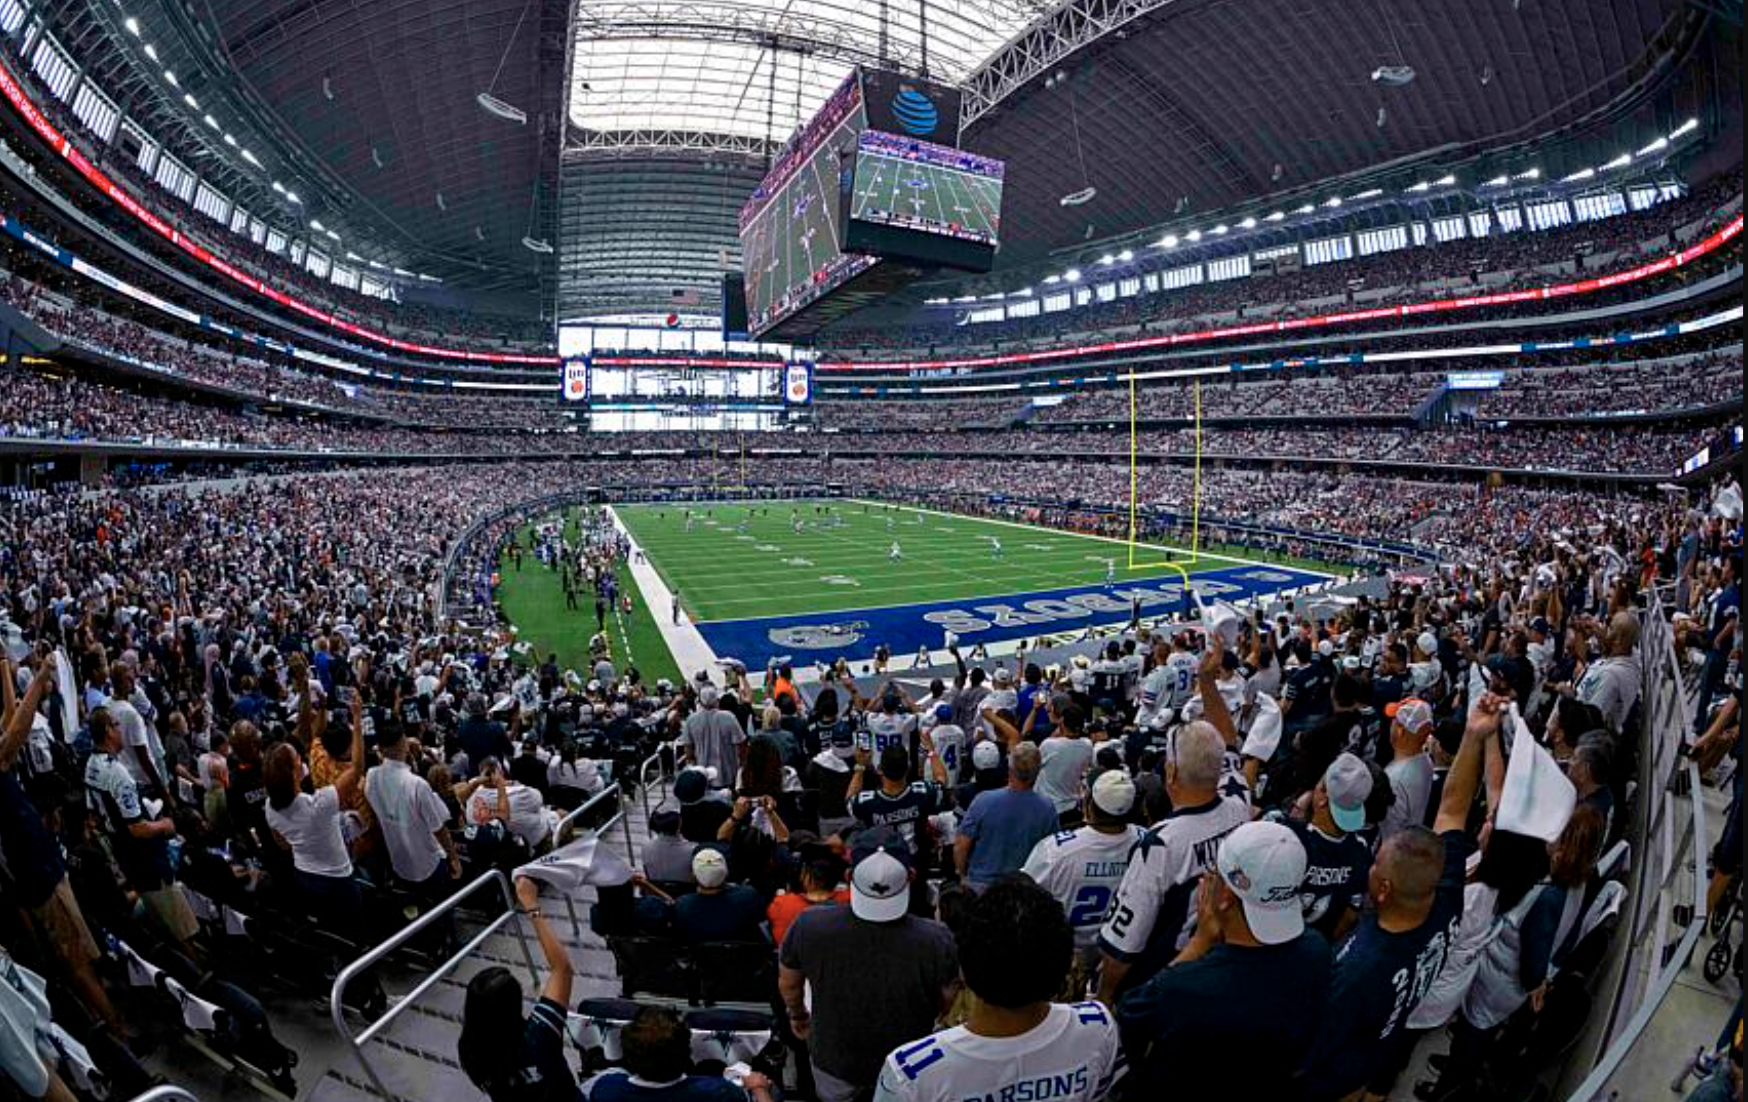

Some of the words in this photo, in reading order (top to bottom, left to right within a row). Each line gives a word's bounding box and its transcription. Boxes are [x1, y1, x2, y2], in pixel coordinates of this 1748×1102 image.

[871, 804, 920, 827] PARSONS
[895, 1037, 944, 1080] 11
[963, 1066, 1088, 1102] RSONS
